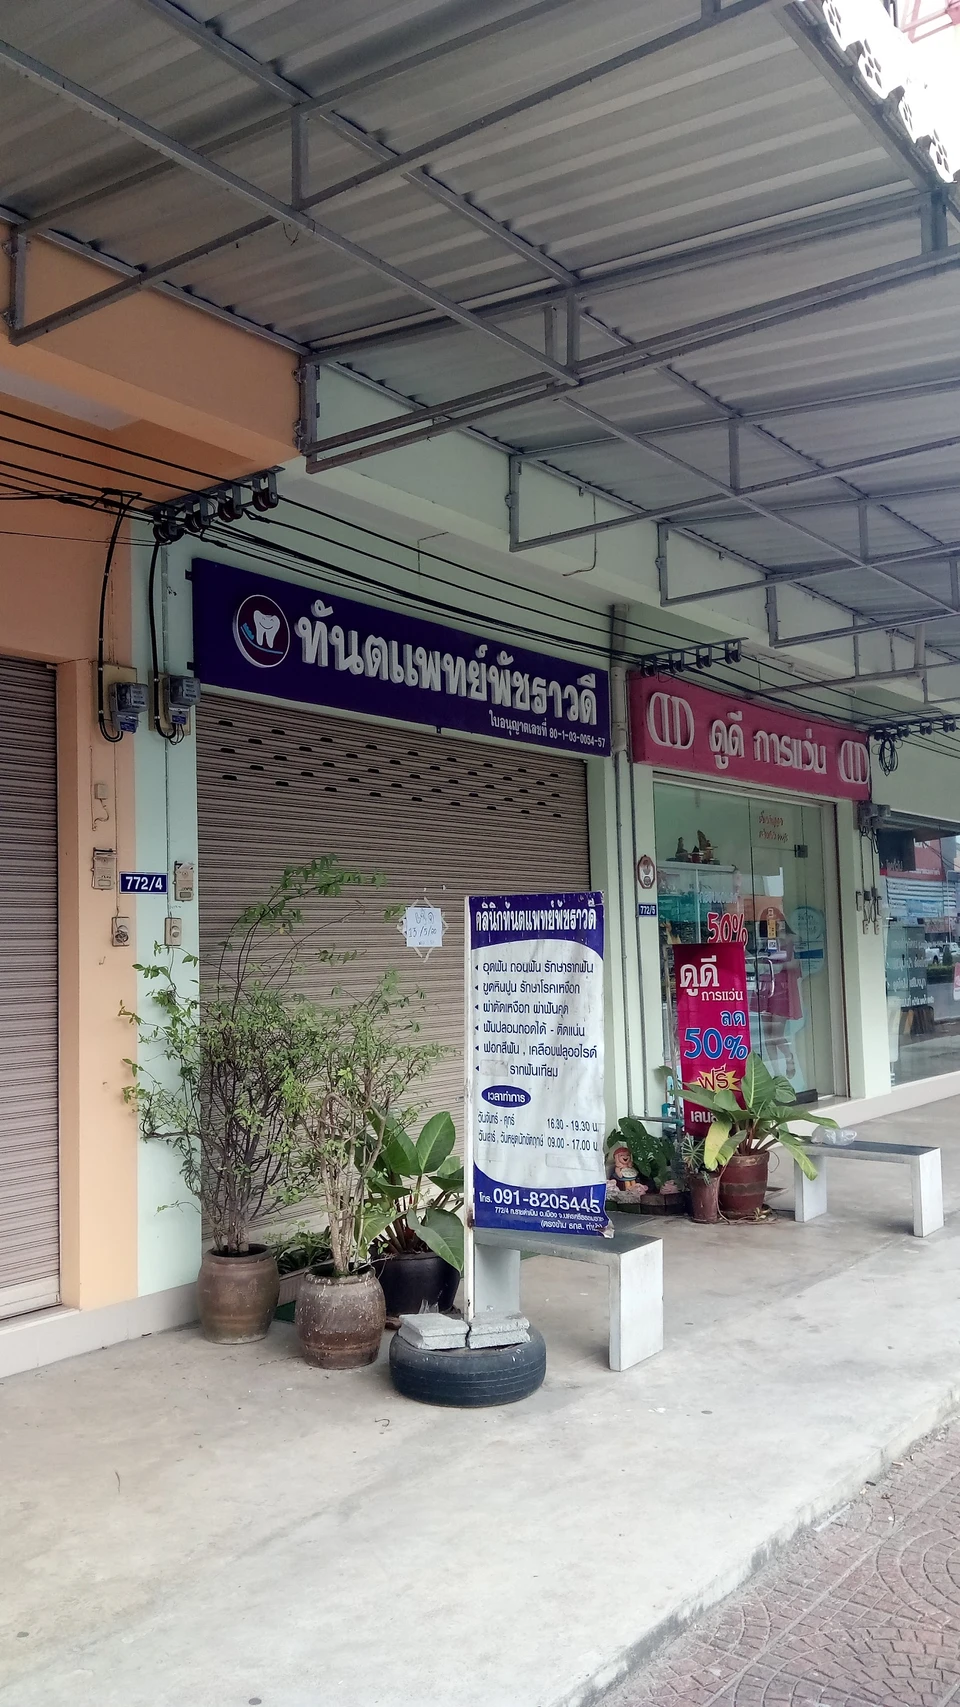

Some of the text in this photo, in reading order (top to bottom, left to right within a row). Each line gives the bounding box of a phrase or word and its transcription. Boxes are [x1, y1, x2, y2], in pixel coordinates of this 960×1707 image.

[294, 599, 598, 727] ทันตแพทย์พัชราวดี
[488, 709, 606, 749] ใบอนุญาตเลขที่ 80-1-03-0054-57
[708, 710, 745, 770] ดูดี
[753, 728, 828, 775] การแว่น
[125, 876, 163, 891] 772/4
[639, 905, 656, 915] 772/5
[706, 911, 749, 949] 50%
[482, 960, 594, 975] อุดฟัน ถอนฟัน รักษารากฟัน
[679, 955, 720, 997] ดูดี
[482, 979, 580, 996] ขูดหินปูน รักษาโรคเหงือก
[701, 988, 744, 1002] การแว่น
[483, 1000, 569, 1018] ผ่าตัดเหงือก ผ่าฟันคุด
[720, 1010, 747, 1027] ลด
[483, 1020, 547, 1035] ฟันปลอมถอดได้
[556, 1024, 585, 1037] ติดแน่น
[483, 1040, 519, 1054] ฟอกสีฟัน
[528, 1042, 598, 1061] เคลือบฟลูออไรด์
[684, 1027, 749, 1060] 50%
[509, 1063, 558, 1078] รากฟันเทียม
[697, 1062, 730, 1091] ฟรี
[487, 1090, 526, 1103] เวลาทำการ
[546, 1118, 564, 1130] 16.30
[570, 1120, 591, 1132] 19.30
[547, 1136, 565, 1149] 09.00
[571, 1139, 591, 1151] 17.00
[478, 1187, 601, 1215] โทร. 091-8205445
